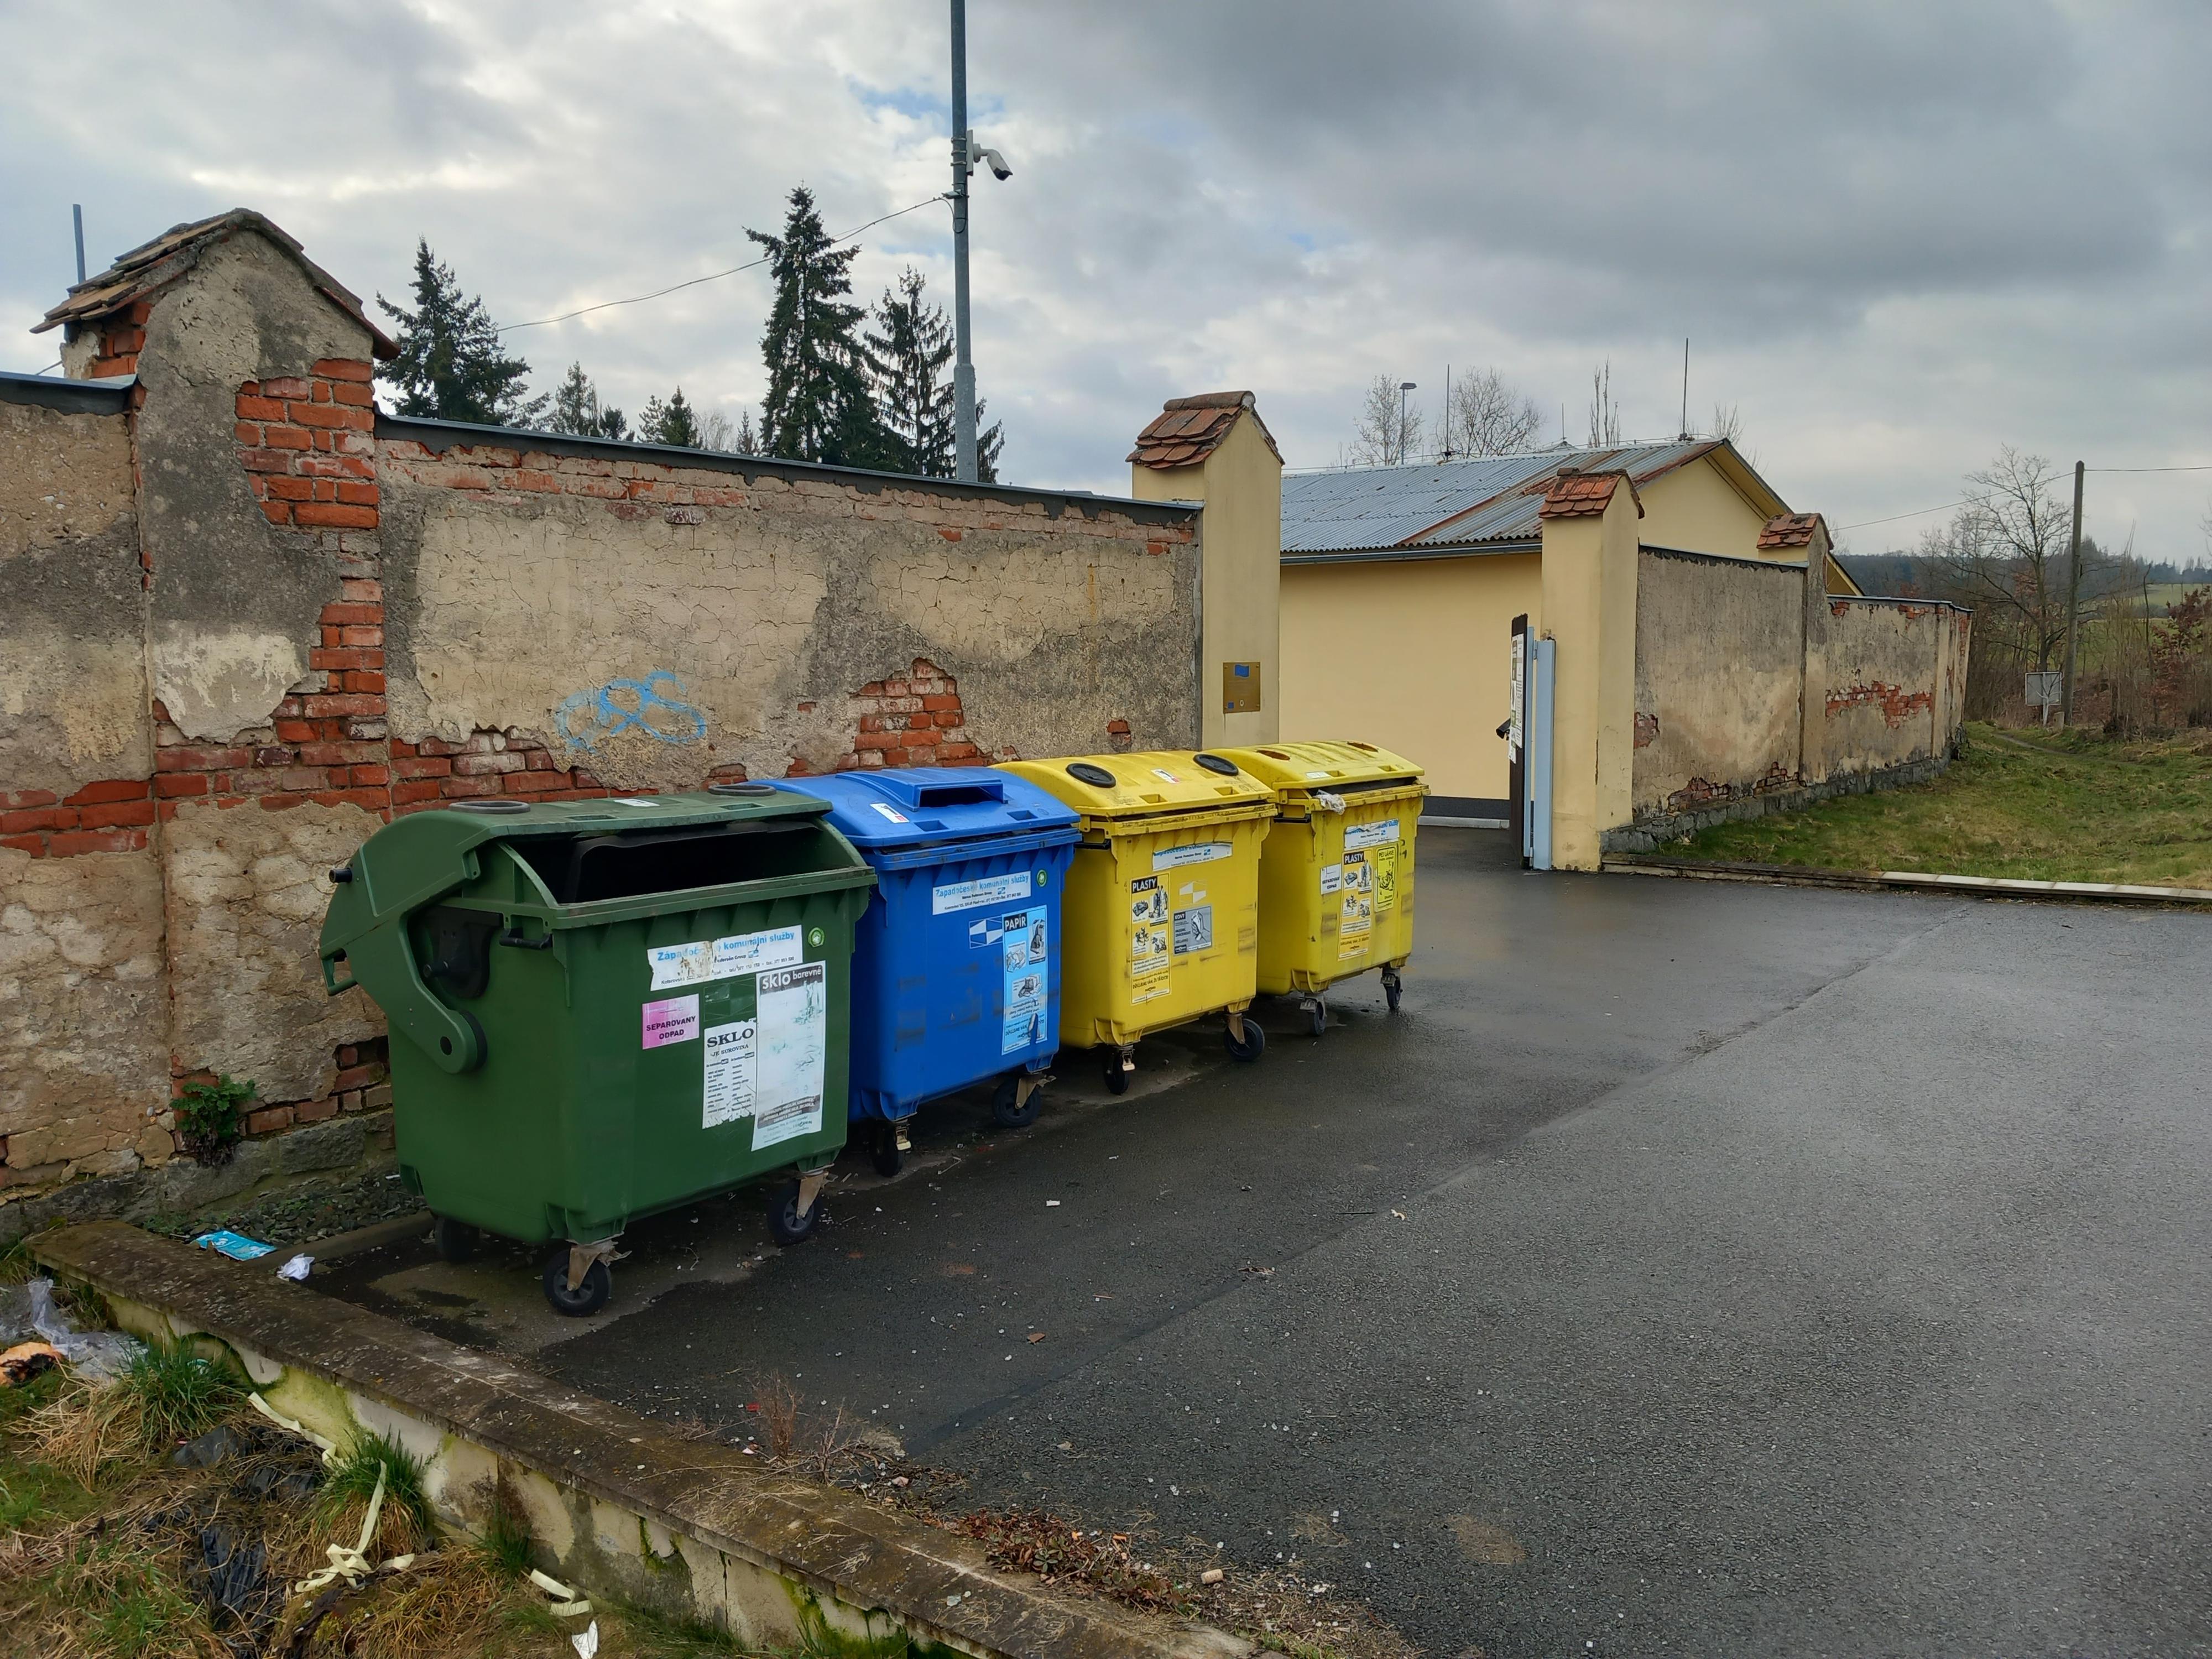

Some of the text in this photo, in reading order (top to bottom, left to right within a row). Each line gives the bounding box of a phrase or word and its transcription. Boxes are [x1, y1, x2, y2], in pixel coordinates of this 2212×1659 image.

[1345, 853, 1363, 864] PLASTY
[1011, 875, 1029, 885] služby
[1133, 878, 1156, 893] PLASTY
[1004, 914, 1026, 931] PAPÍR
[769, 932, 795, 942] služby
[762, 966, 821, 989] sklo barevné
[659, 1029, 684, 1040] ODPAD
[707, 1029, 754, 1048] SKLO
[721, 1044, 749, 1055] SUROVINA
